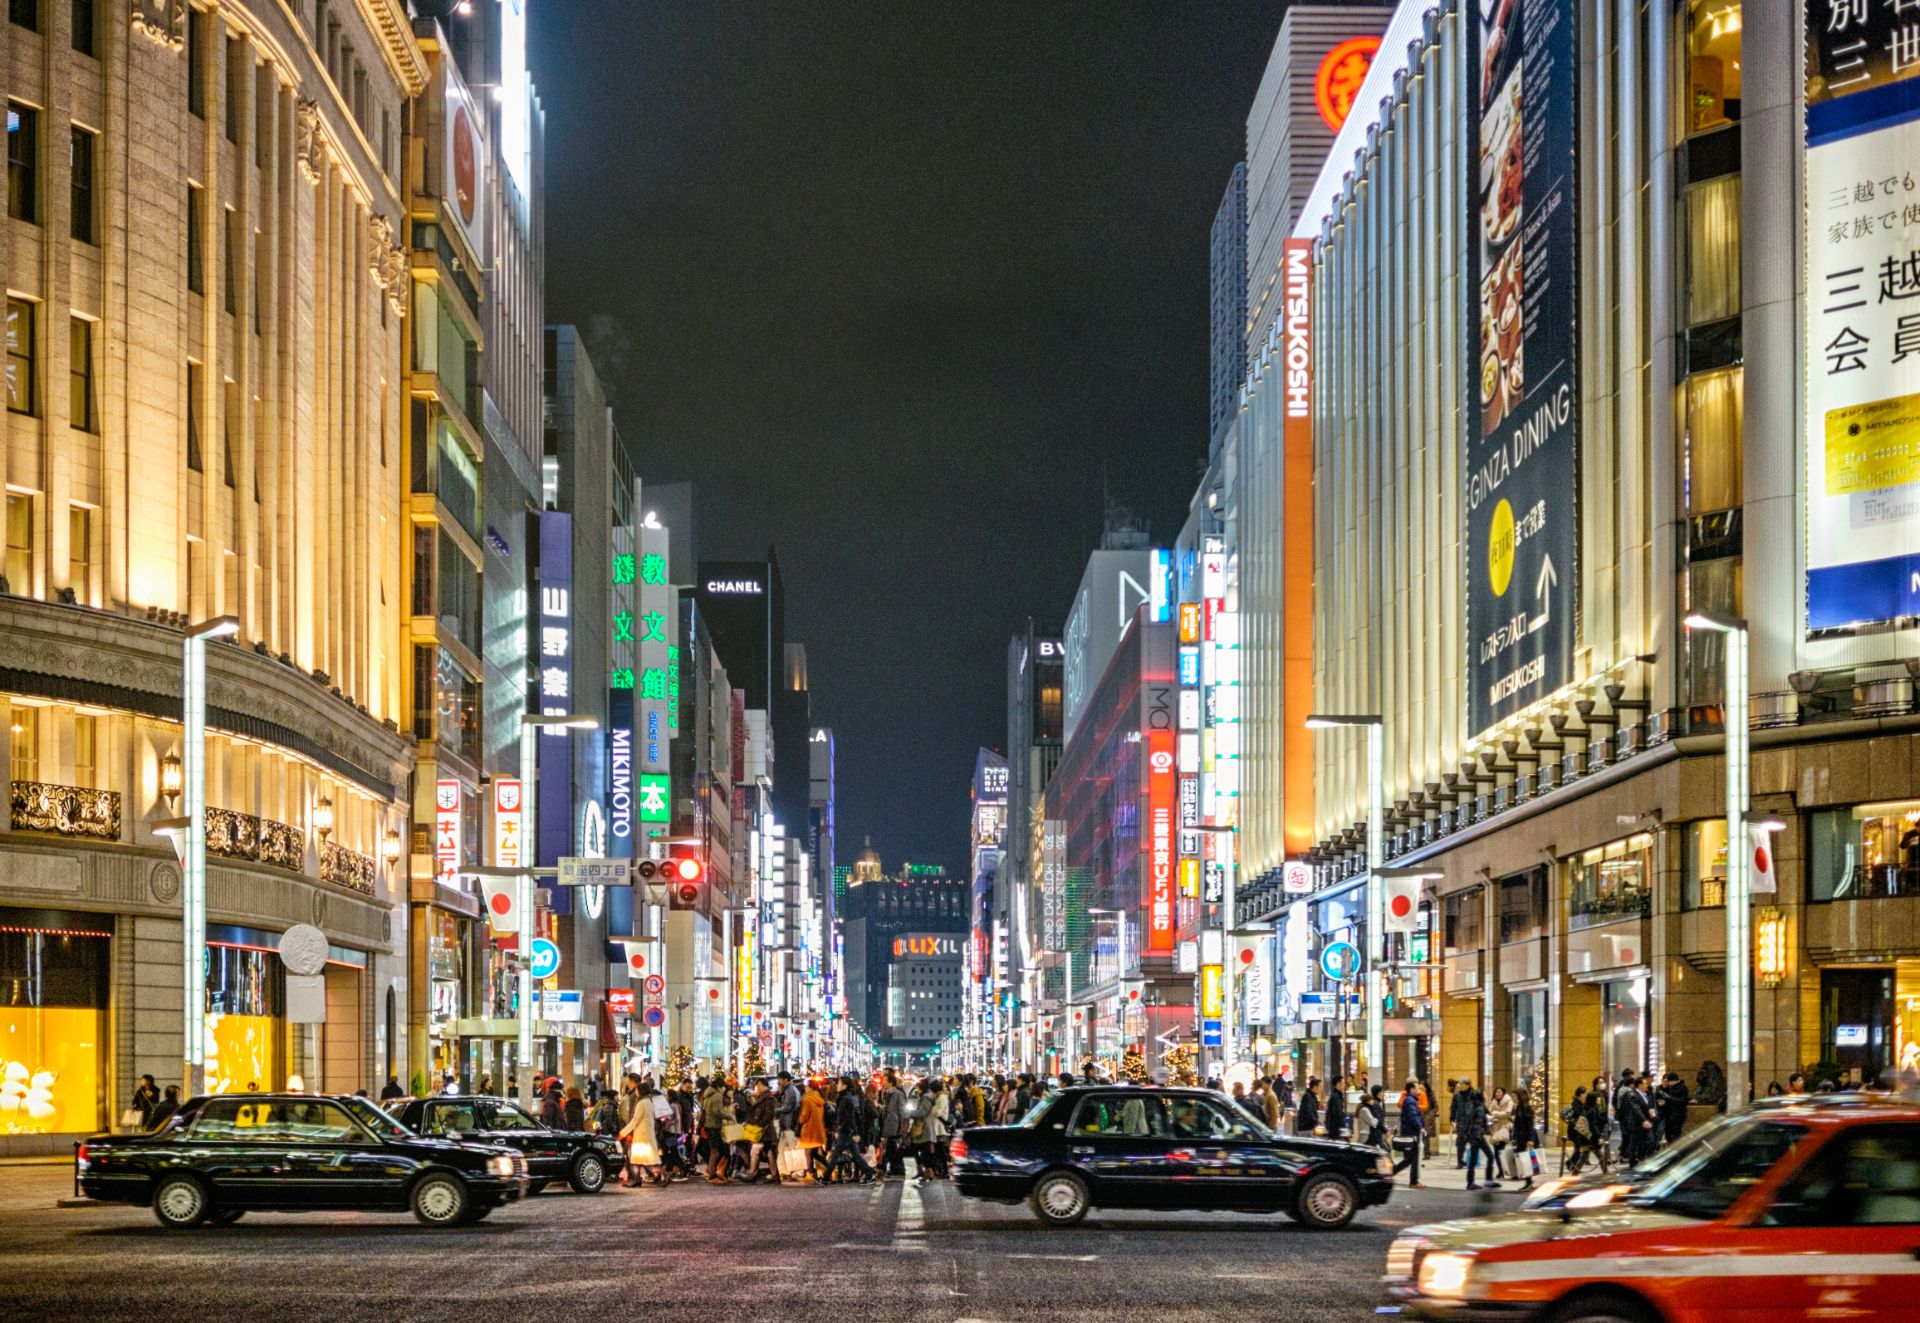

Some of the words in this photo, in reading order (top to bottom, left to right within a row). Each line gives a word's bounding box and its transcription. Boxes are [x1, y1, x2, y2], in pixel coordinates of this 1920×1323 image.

[1828, 171, 1915, 210] 三越でも
[1827, 203, 1920, 244] 家族で使
[1823, 250, 1920, 314] 三越
[1288, 249, 1309, 417] MITSUKOSHI
[1470, 443, 1510, 510] GINZA
[1513, 383, 1570, 468] DINING
[708, 581, 762, 593] CHANEL
[641, 553, 667, 700] 教文館
[543, 587, 568, 736] 山野楽器
[1490, 655, 1545, 706] MITSUKOSHI
[649, 711, 659, 740] SINCE
[809, 729, 827, 742] A
[612, 728, 631, 838] MIKIMOTO
[641, 782, 666, 815] 本
[563, 864, 626, 877] 銀座四丁目
[1153, 808, 1169, 931] 三菱東京UFJ銀行
[910, 936, 958, 955] LIXIL
